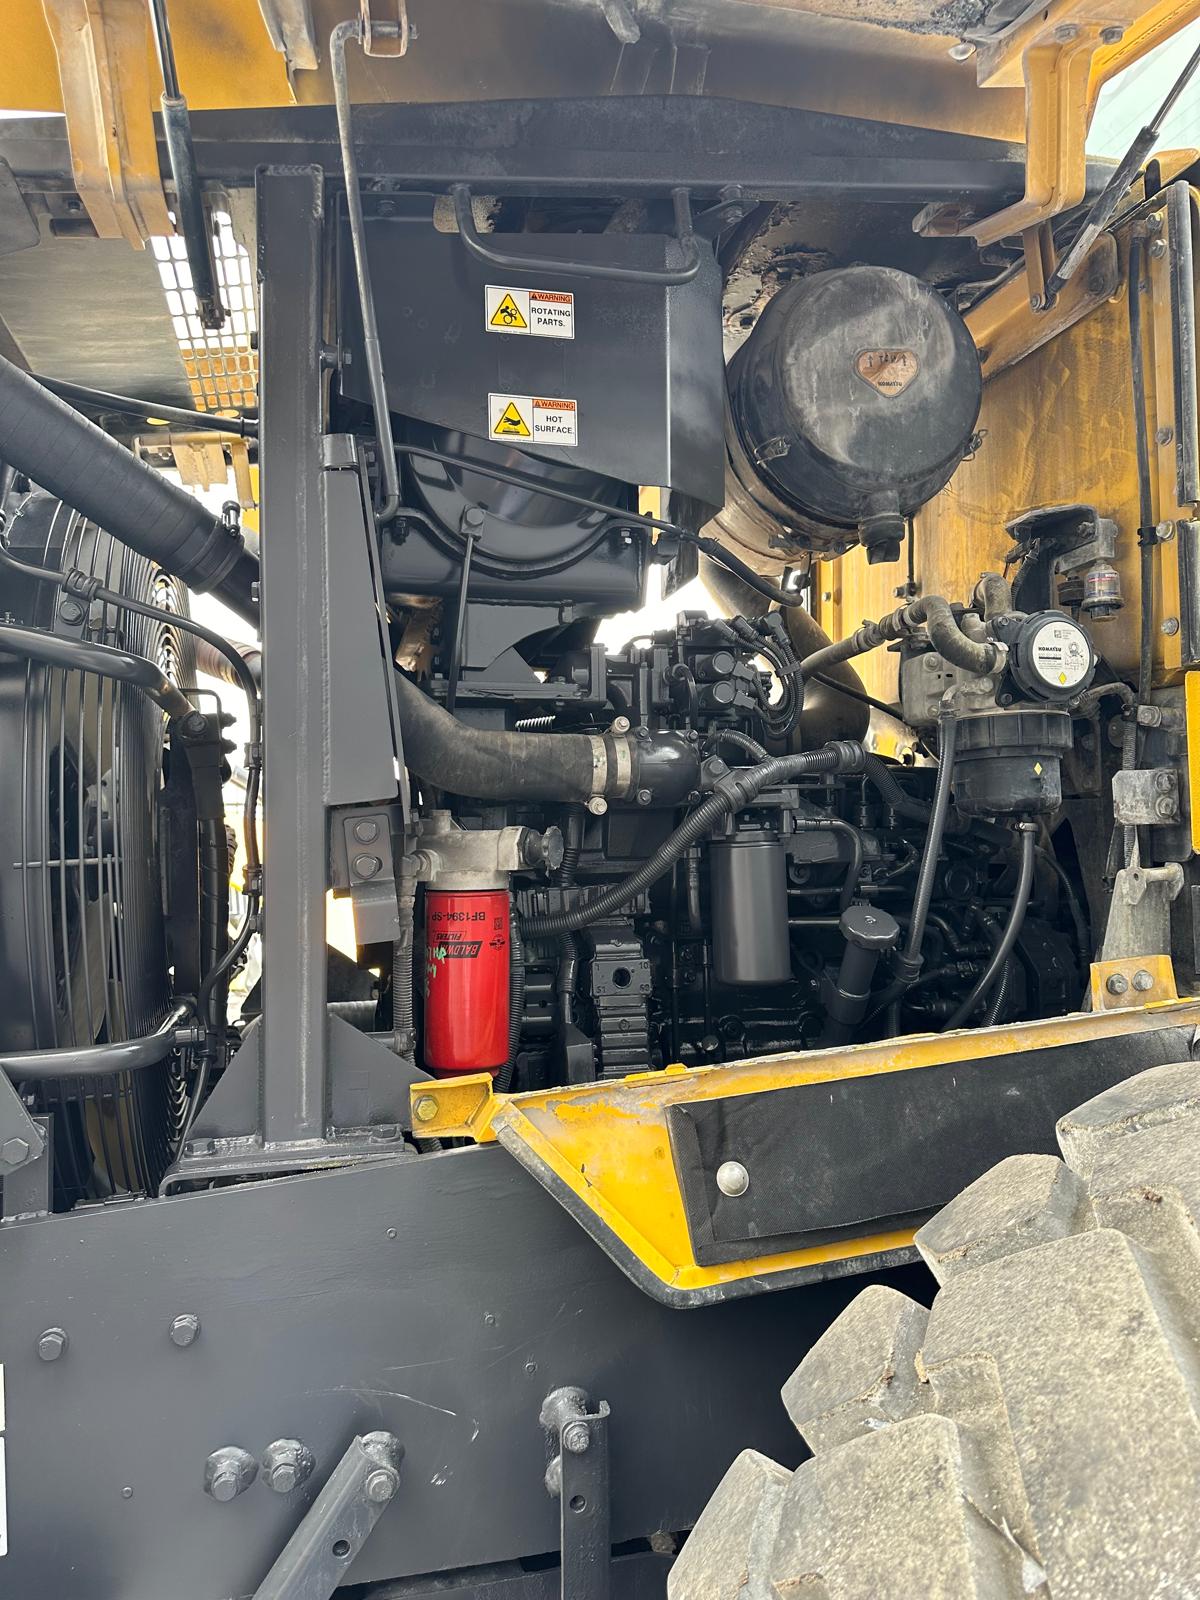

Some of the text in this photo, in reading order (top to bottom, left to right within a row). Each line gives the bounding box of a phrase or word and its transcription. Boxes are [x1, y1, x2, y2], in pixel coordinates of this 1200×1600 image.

[537, 293, 571, 303] WARNING
[532, 307, 571, 317] ROTATING
[538, 318, 565, 327] PARTS.
[541, 400, 574, 409] WARNING
[546, 415, 564, 423] HOT
[535, 425, 575, 434] SURFACE.
[432, 911, 486, 922] BF1394-SP
[436, 933, 462, 941] FILTERS
[440, 944, 479, 955] BALDWI
[639, 961, 648, 969] 10
